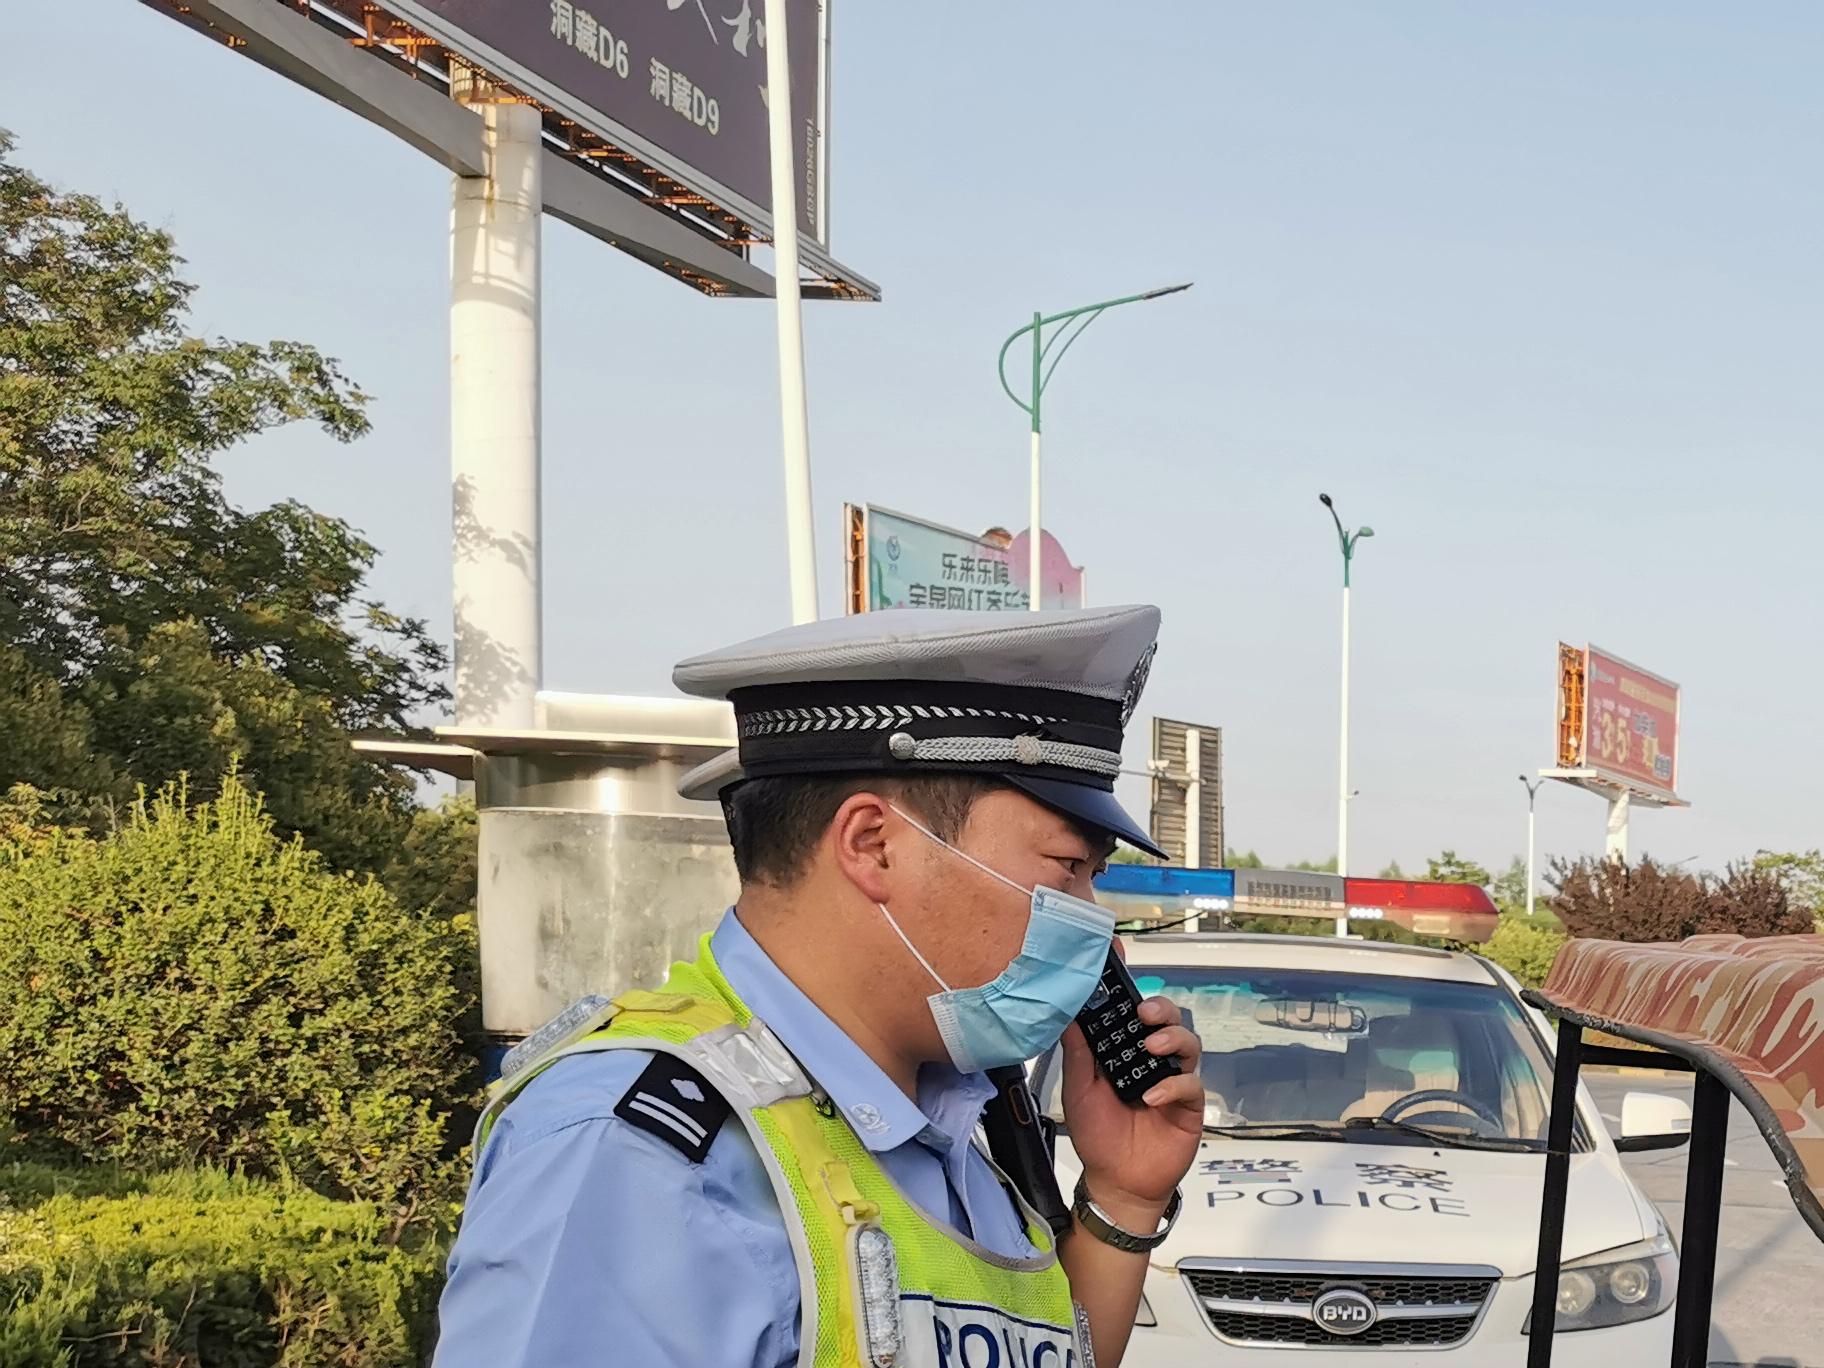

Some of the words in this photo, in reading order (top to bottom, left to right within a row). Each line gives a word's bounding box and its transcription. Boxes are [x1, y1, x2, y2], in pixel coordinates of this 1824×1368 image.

[650, 56, 720, 135] 洞藏D9
[1206, 1189, 1471, 1216] POLICE
[1322, 1304, 1367, 1321] BYD
